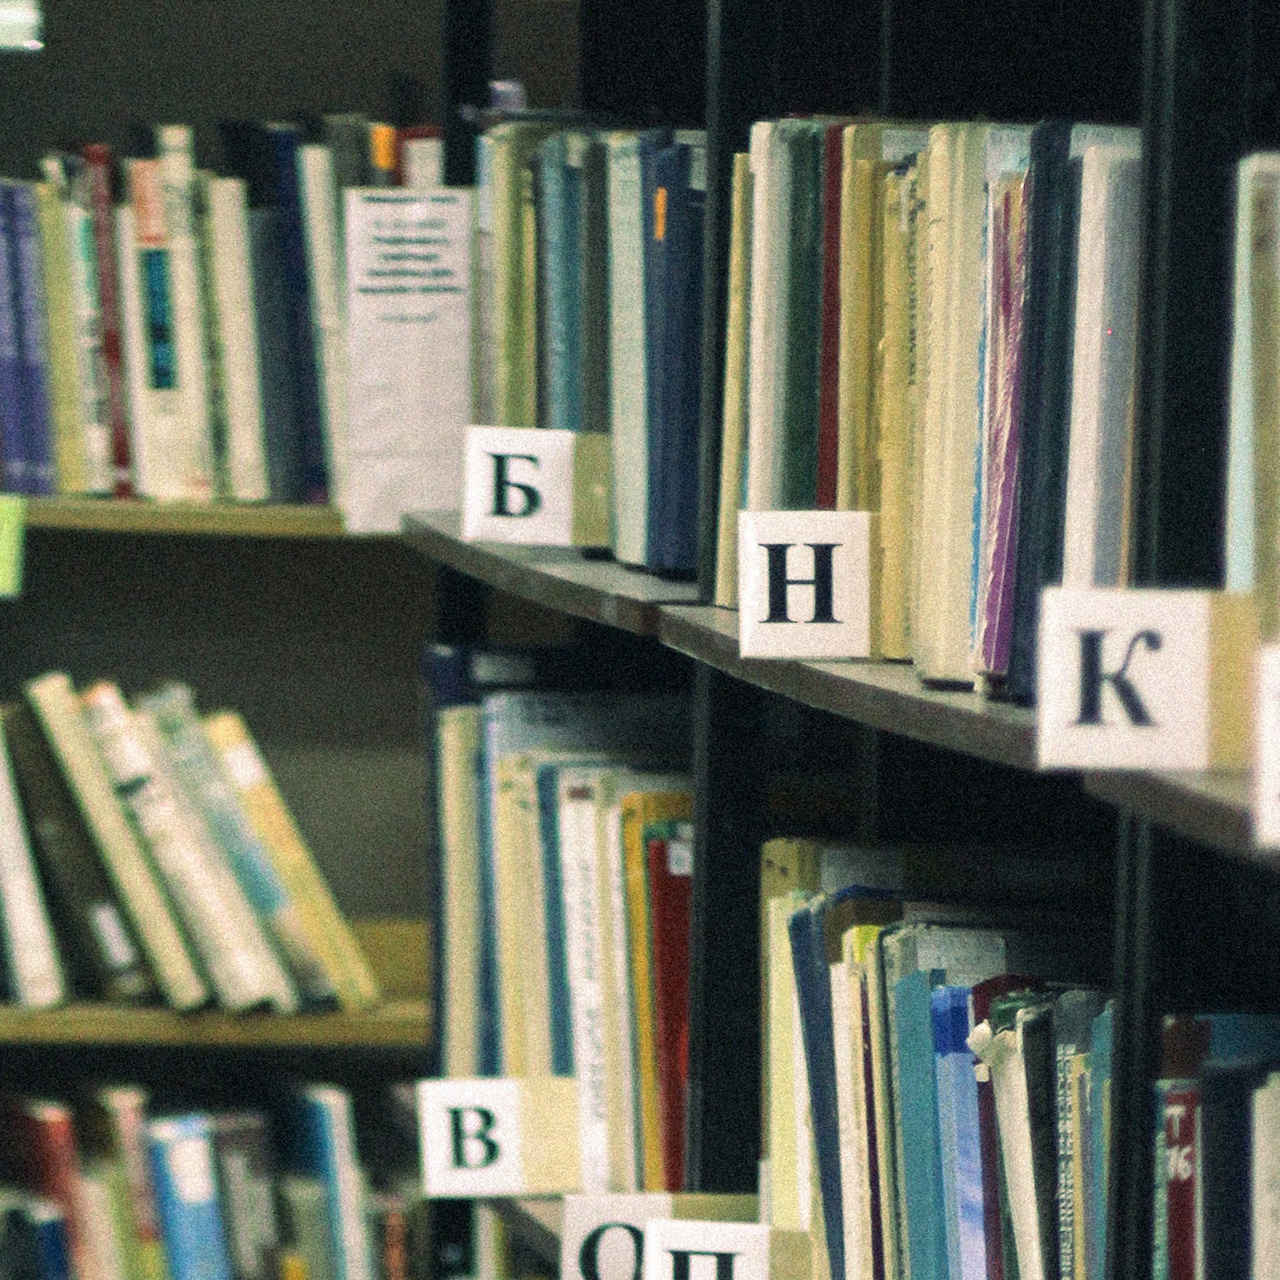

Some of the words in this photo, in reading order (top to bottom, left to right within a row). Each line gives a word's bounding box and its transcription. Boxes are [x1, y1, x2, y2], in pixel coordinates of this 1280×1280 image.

[491, 453, 543, 518] Б
[758, 542, 843, 625] Н
[1075, 628, 1163, 728] К
[448, 1107, 501, 1169] В
